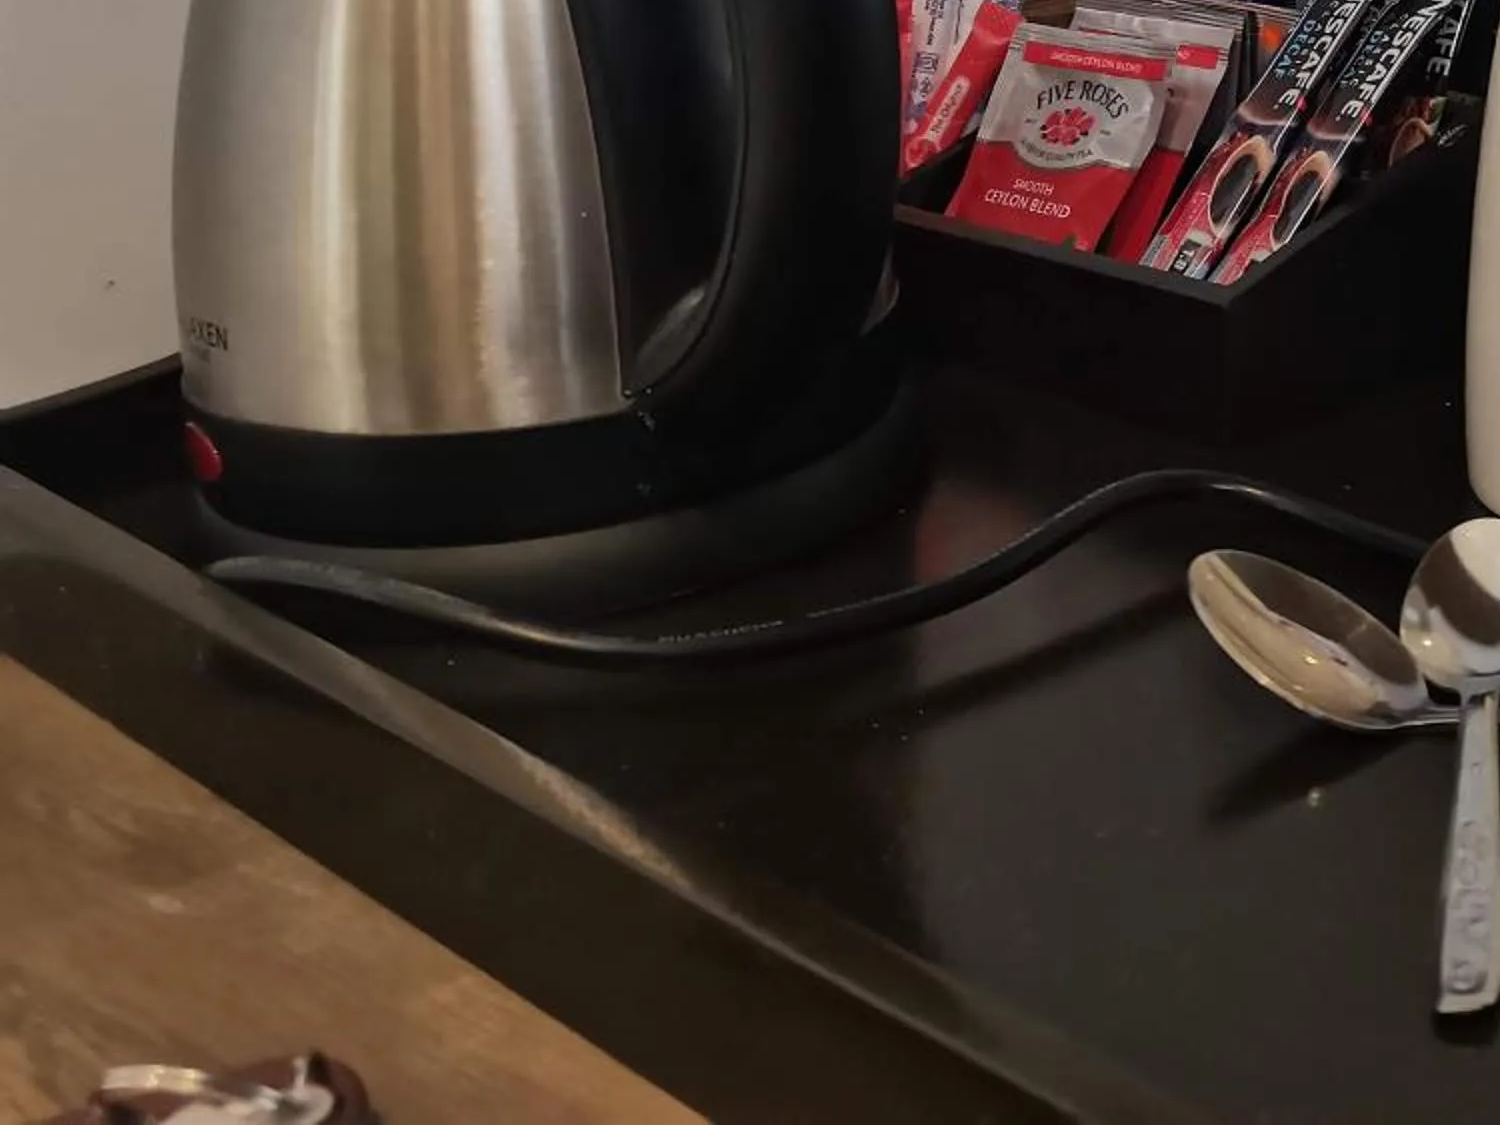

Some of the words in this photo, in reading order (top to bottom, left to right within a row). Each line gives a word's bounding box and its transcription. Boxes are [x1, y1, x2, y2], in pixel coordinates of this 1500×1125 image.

[1037, 80, 1077, 110] FIVE
[1080, 80, 1129, 119] ROSES
[1013, 178, 1055, 196] SMOOTH
[984, 188, 1029, 209] CEYLON
[1029, 198, 1071, 218] BLEND
